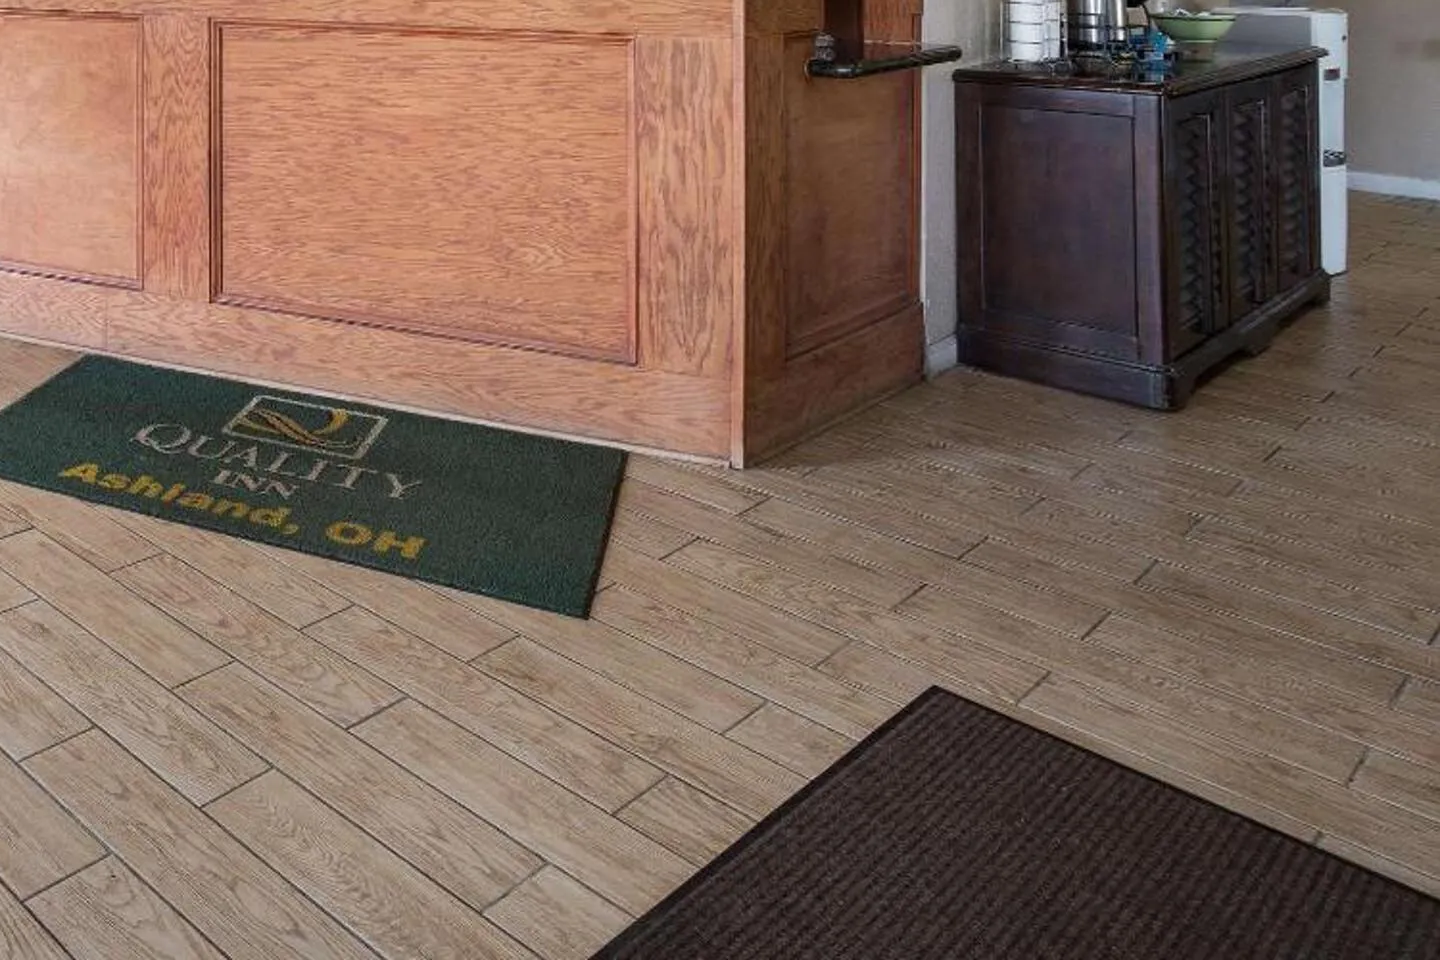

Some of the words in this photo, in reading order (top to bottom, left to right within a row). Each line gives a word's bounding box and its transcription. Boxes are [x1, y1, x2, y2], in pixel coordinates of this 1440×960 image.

[131, 423, 421, 499] QUALITY
[213, 469, 300, 500] INN
[59, 463, 300, 535] Ashland,
[325, 521, 425, 559] OH
